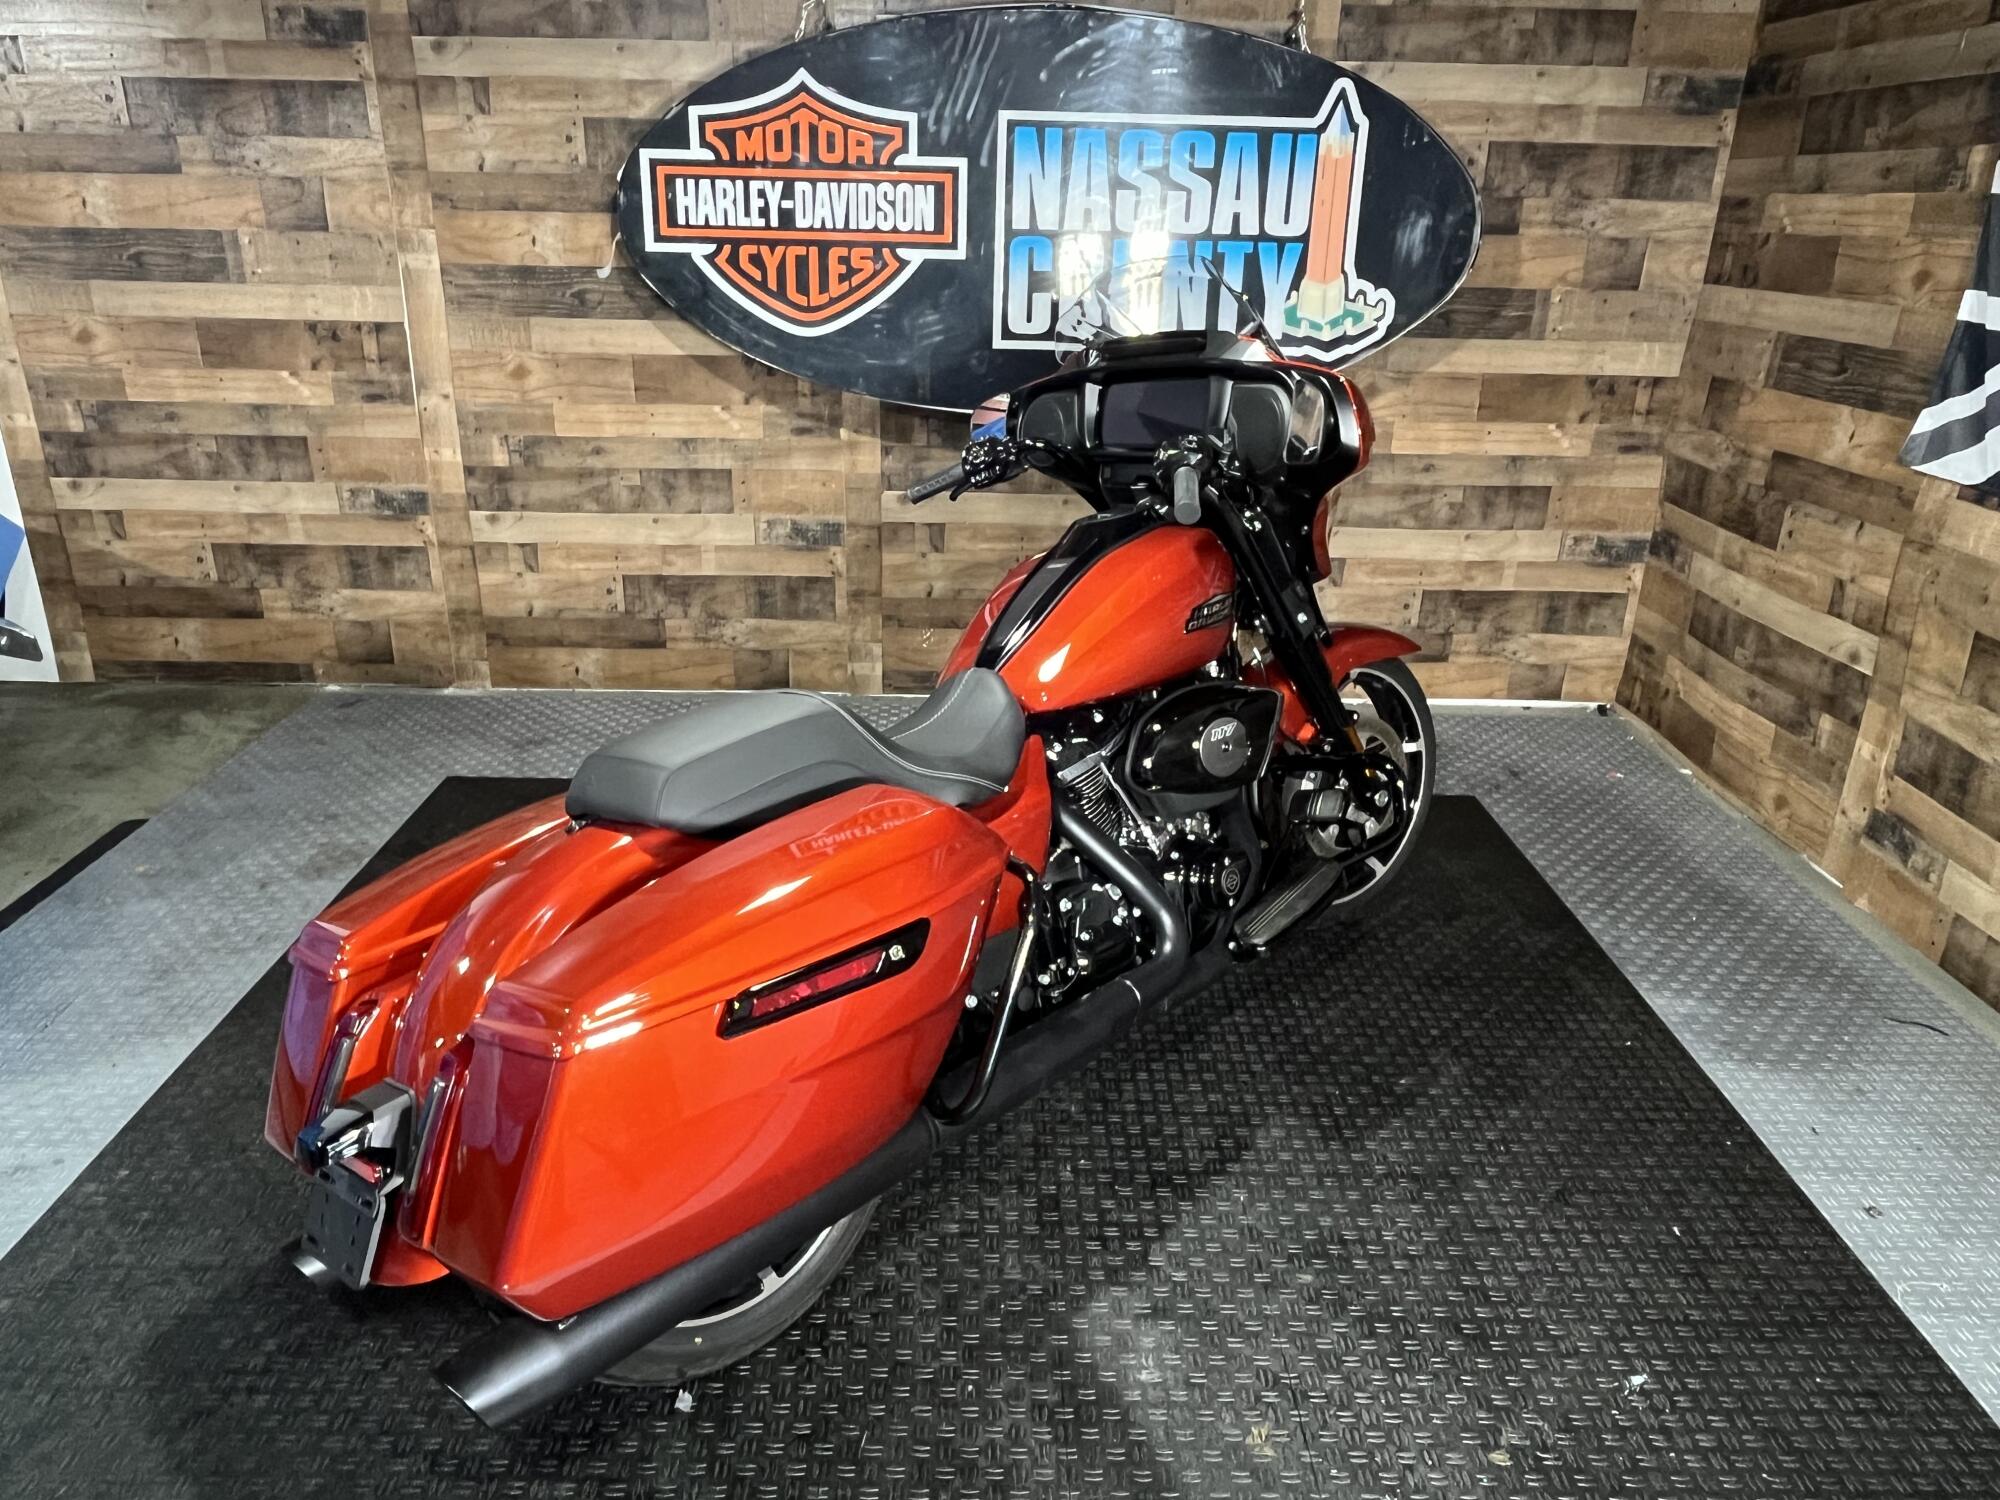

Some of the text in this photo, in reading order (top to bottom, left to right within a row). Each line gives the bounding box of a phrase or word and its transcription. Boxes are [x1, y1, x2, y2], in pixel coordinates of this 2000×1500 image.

[736, 107, 874, 165] MOTOR
[675, 177, 935, 232] HARLEY-DAVIDSON
[1011, 125, 1321, 237] NASSAU
[739, 244, 875, 306] CYCLES
[1007, 235, 1304, 340] CNTY
